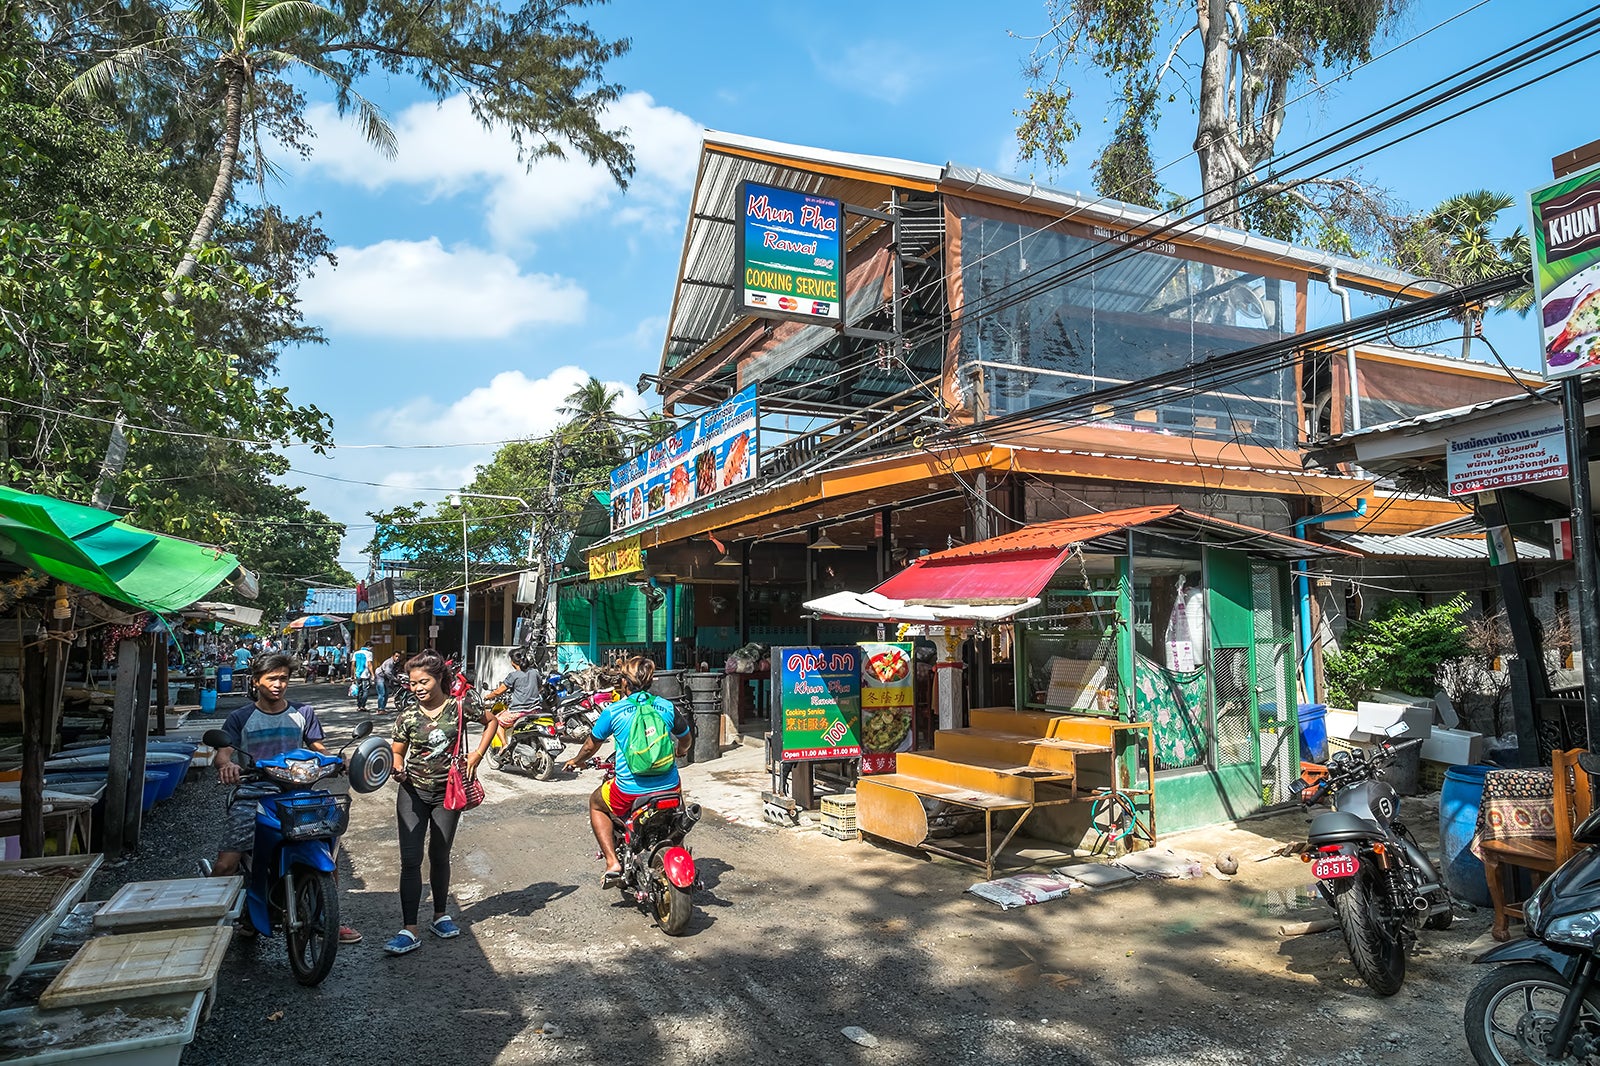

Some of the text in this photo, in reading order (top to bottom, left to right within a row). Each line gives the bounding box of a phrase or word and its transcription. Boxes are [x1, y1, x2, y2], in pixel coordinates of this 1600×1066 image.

[747, 194, 837, 231] Khun Pha
[1549, 204, 1596, 247] KHUN
[763, 231, 817, 256] Rawai
[746, 268, 837, 298] COOKING SERVICE
[668, 436, 683, 451] Pha
[1452, 431, 1529, 451] รับสมัครพนักงาน
[1455, 454, 1560, 480] สามารถพูดภาษาอังกฤษได้
[1466, 447, 1546, 468] พนักงานรับออเดอร์
[787, 653, 854, 679] คุณ ภา
[794, 680, 850, 694] Khun Pha
[786, 708, 806, 716] Cooking
[824, 721, 847, 747] 100
[784, 751, 800, 759] Open
